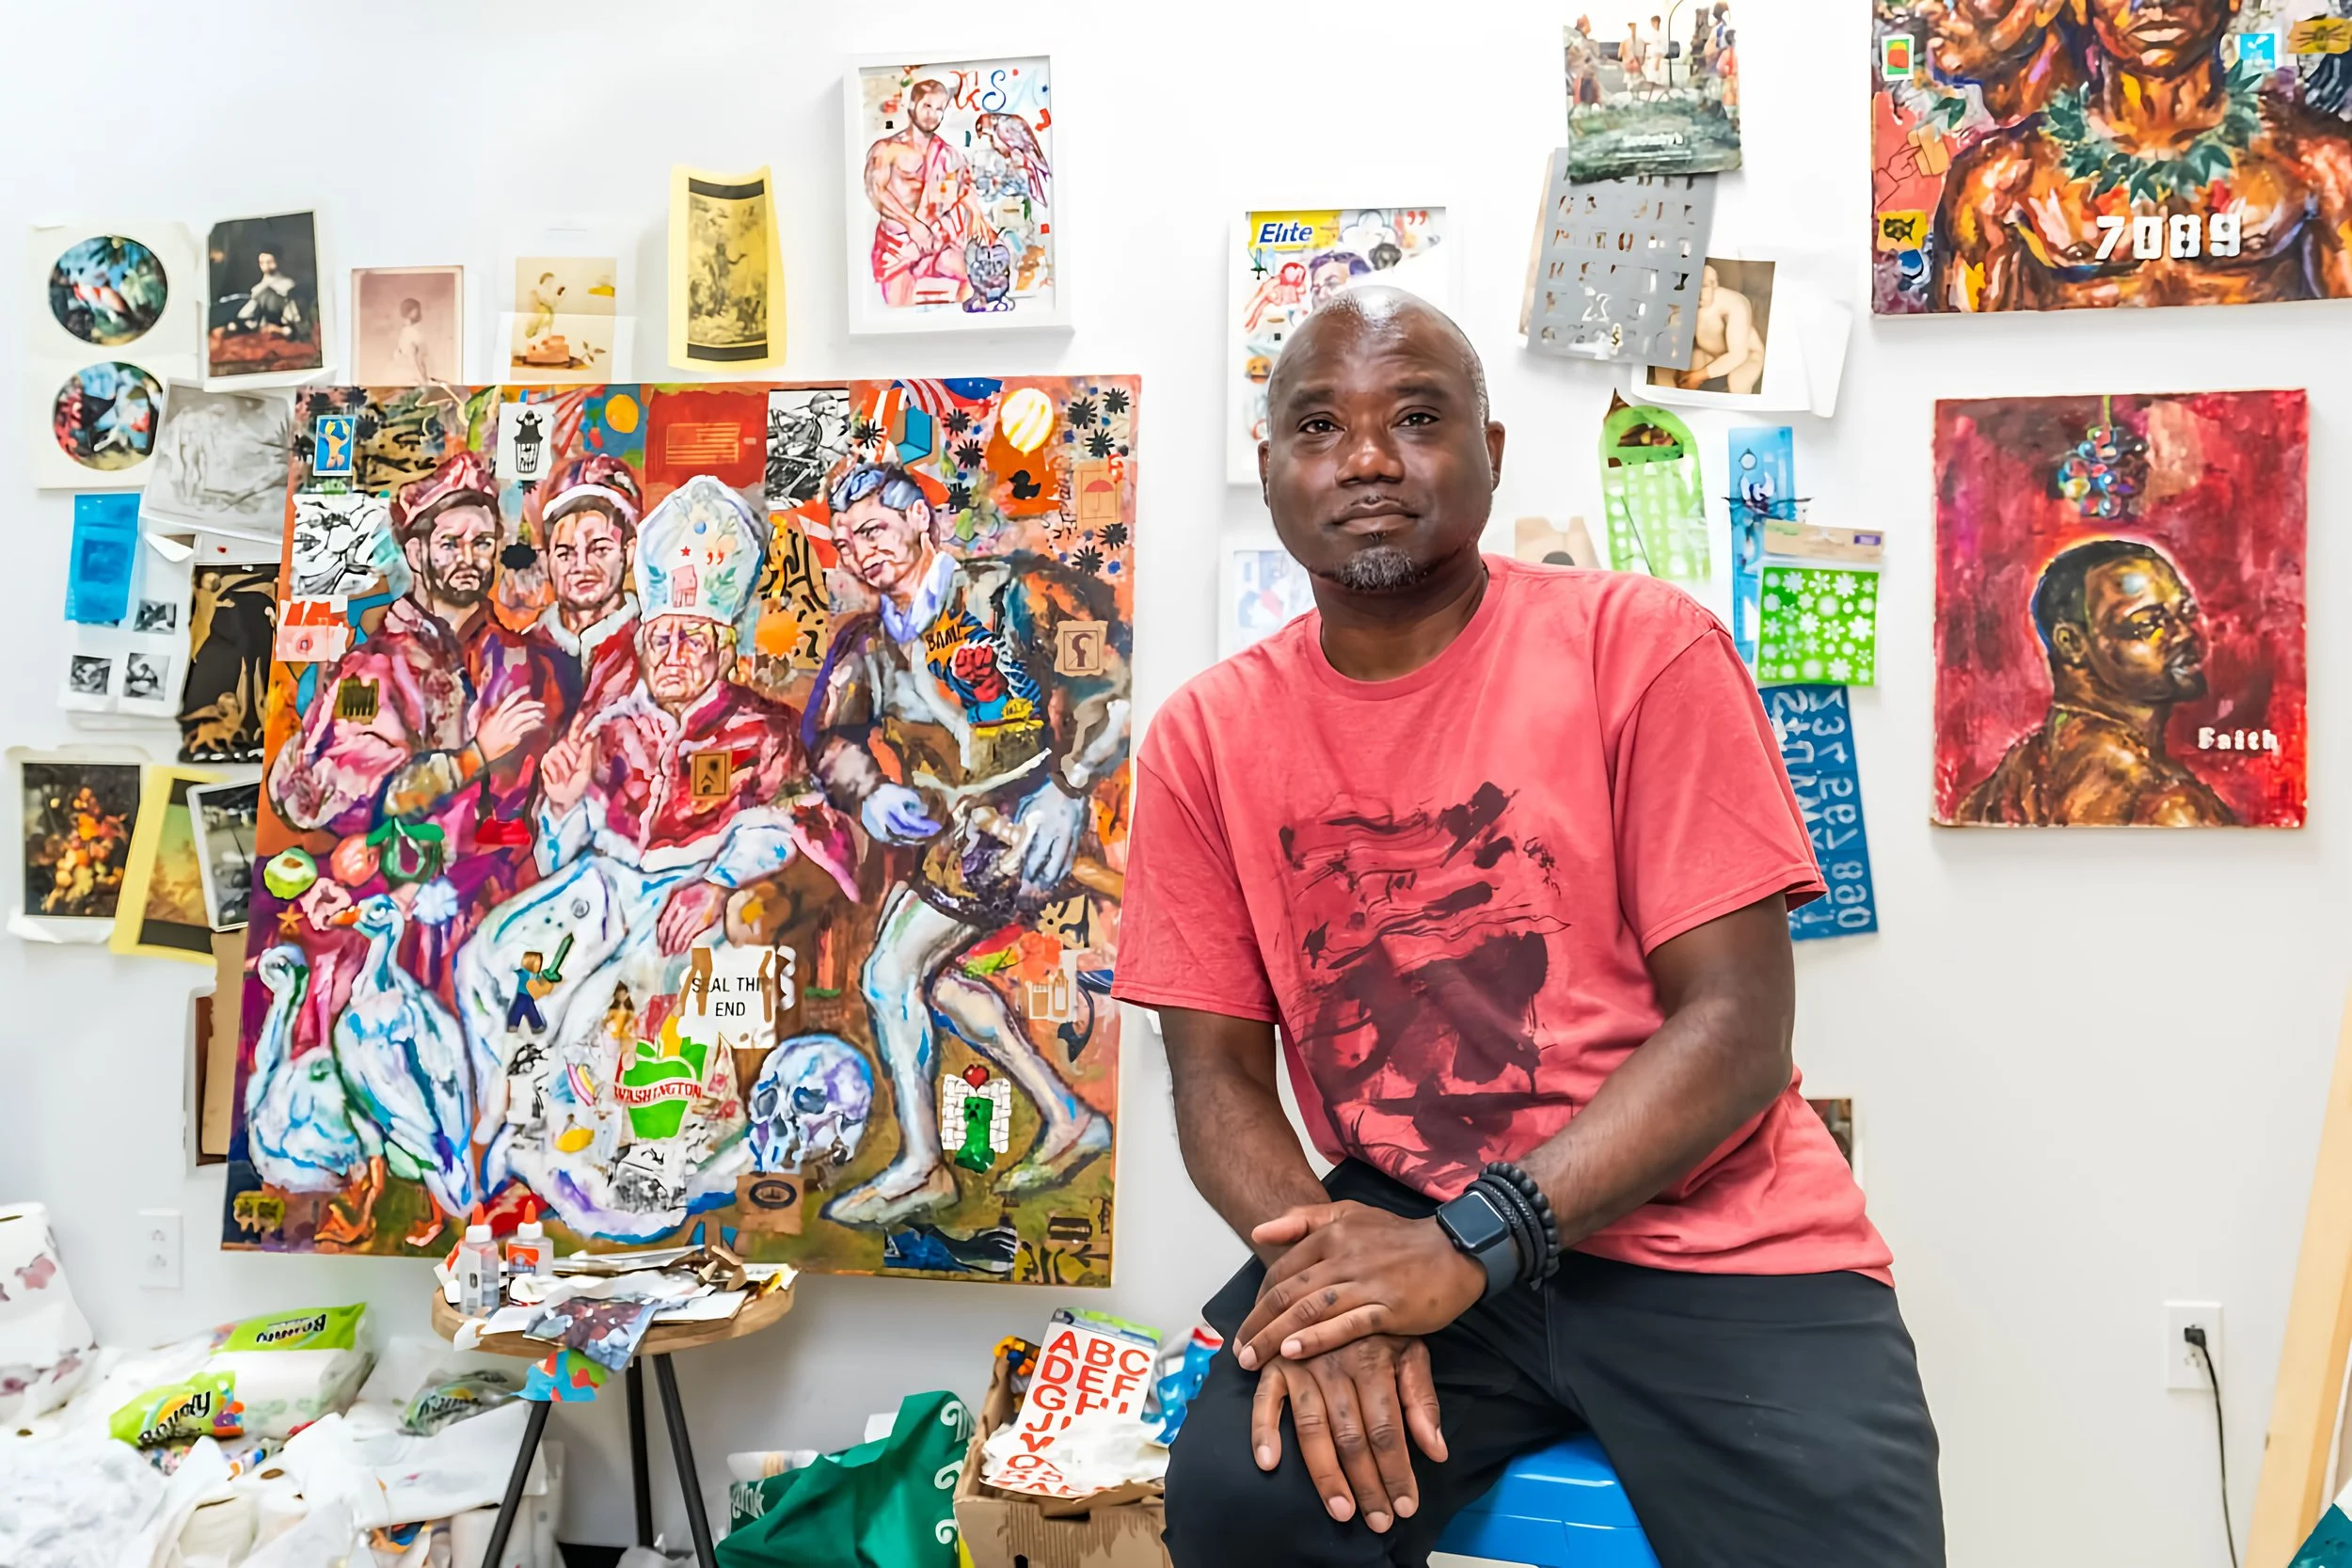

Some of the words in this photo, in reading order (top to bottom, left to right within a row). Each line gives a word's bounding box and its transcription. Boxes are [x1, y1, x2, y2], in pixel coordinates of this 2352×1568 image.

[1259, 222, 1313, 244] Elite
[925, 622, 963, 652] BAM!
[691, 977, 730, 993] SAL
[736, 976, 761, 992] THI
[715, 1002, 746, 1017] END
